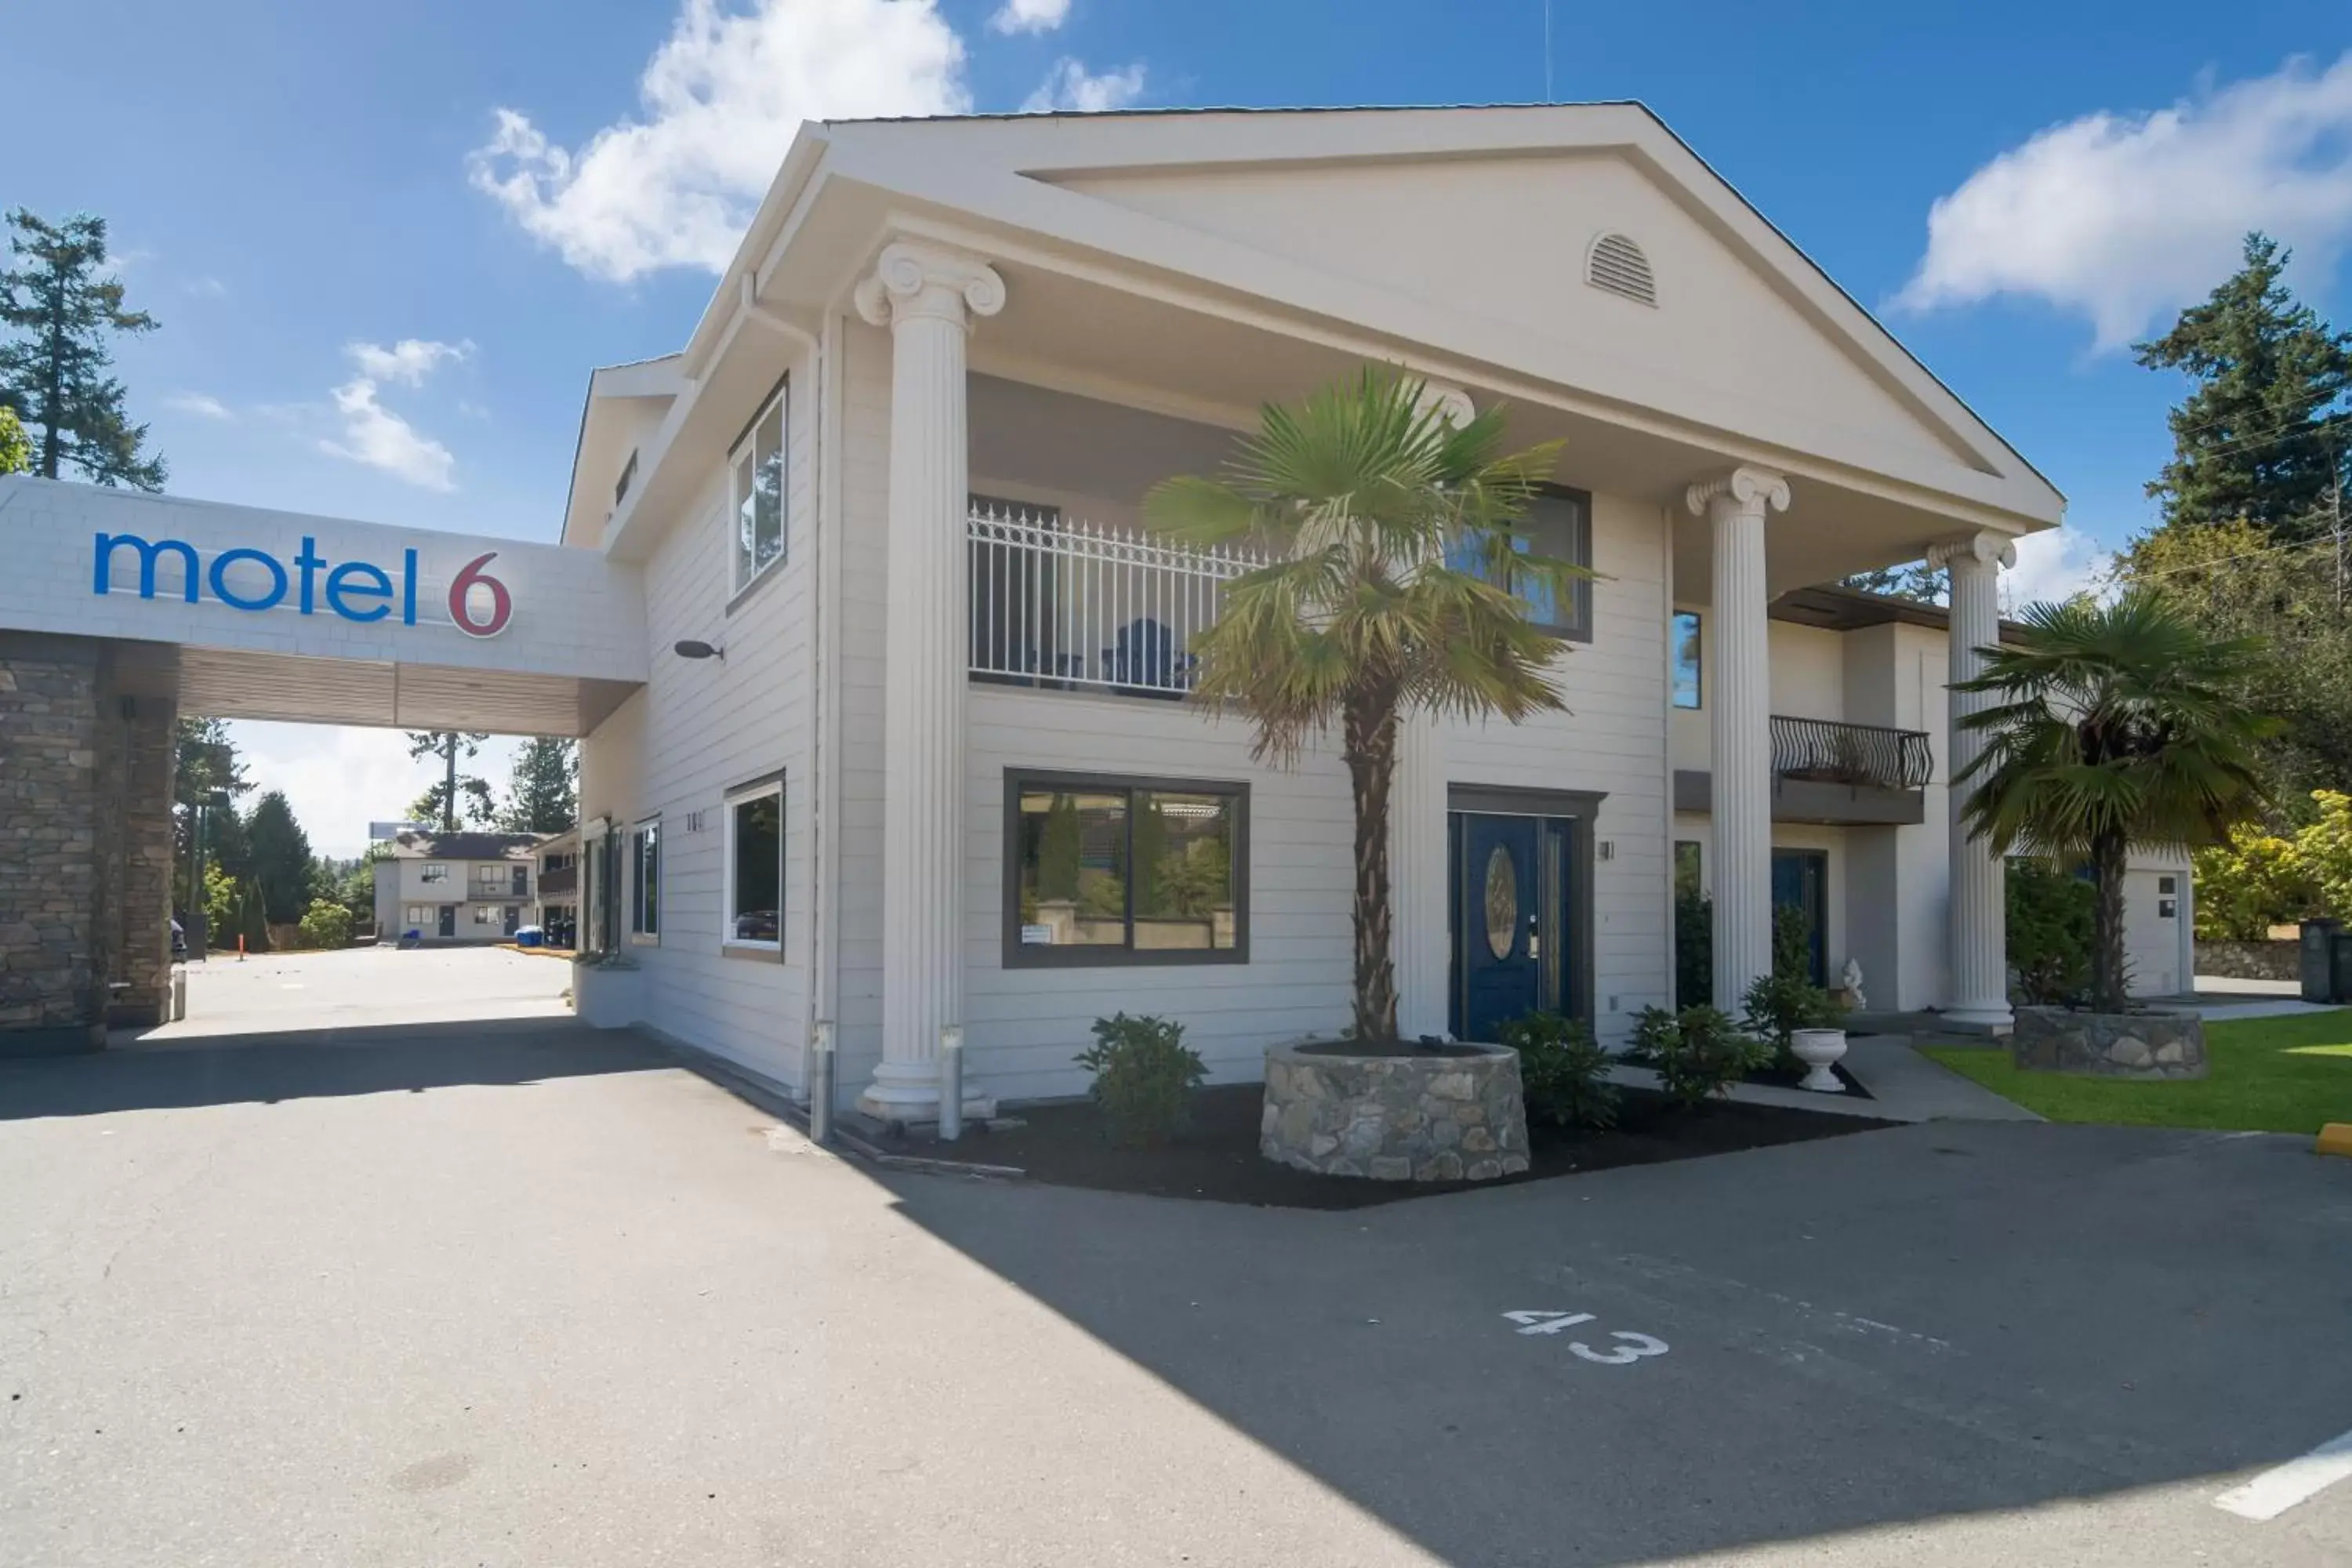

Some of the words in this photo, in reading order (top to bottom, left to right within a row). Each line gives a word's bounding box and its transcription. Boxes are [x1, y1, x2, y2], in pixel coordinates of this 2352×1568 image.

[93, 532, 418, 626] motel
[448, 551, 512, 637] 6
[1501, 1310, 1669, 1364] 43
